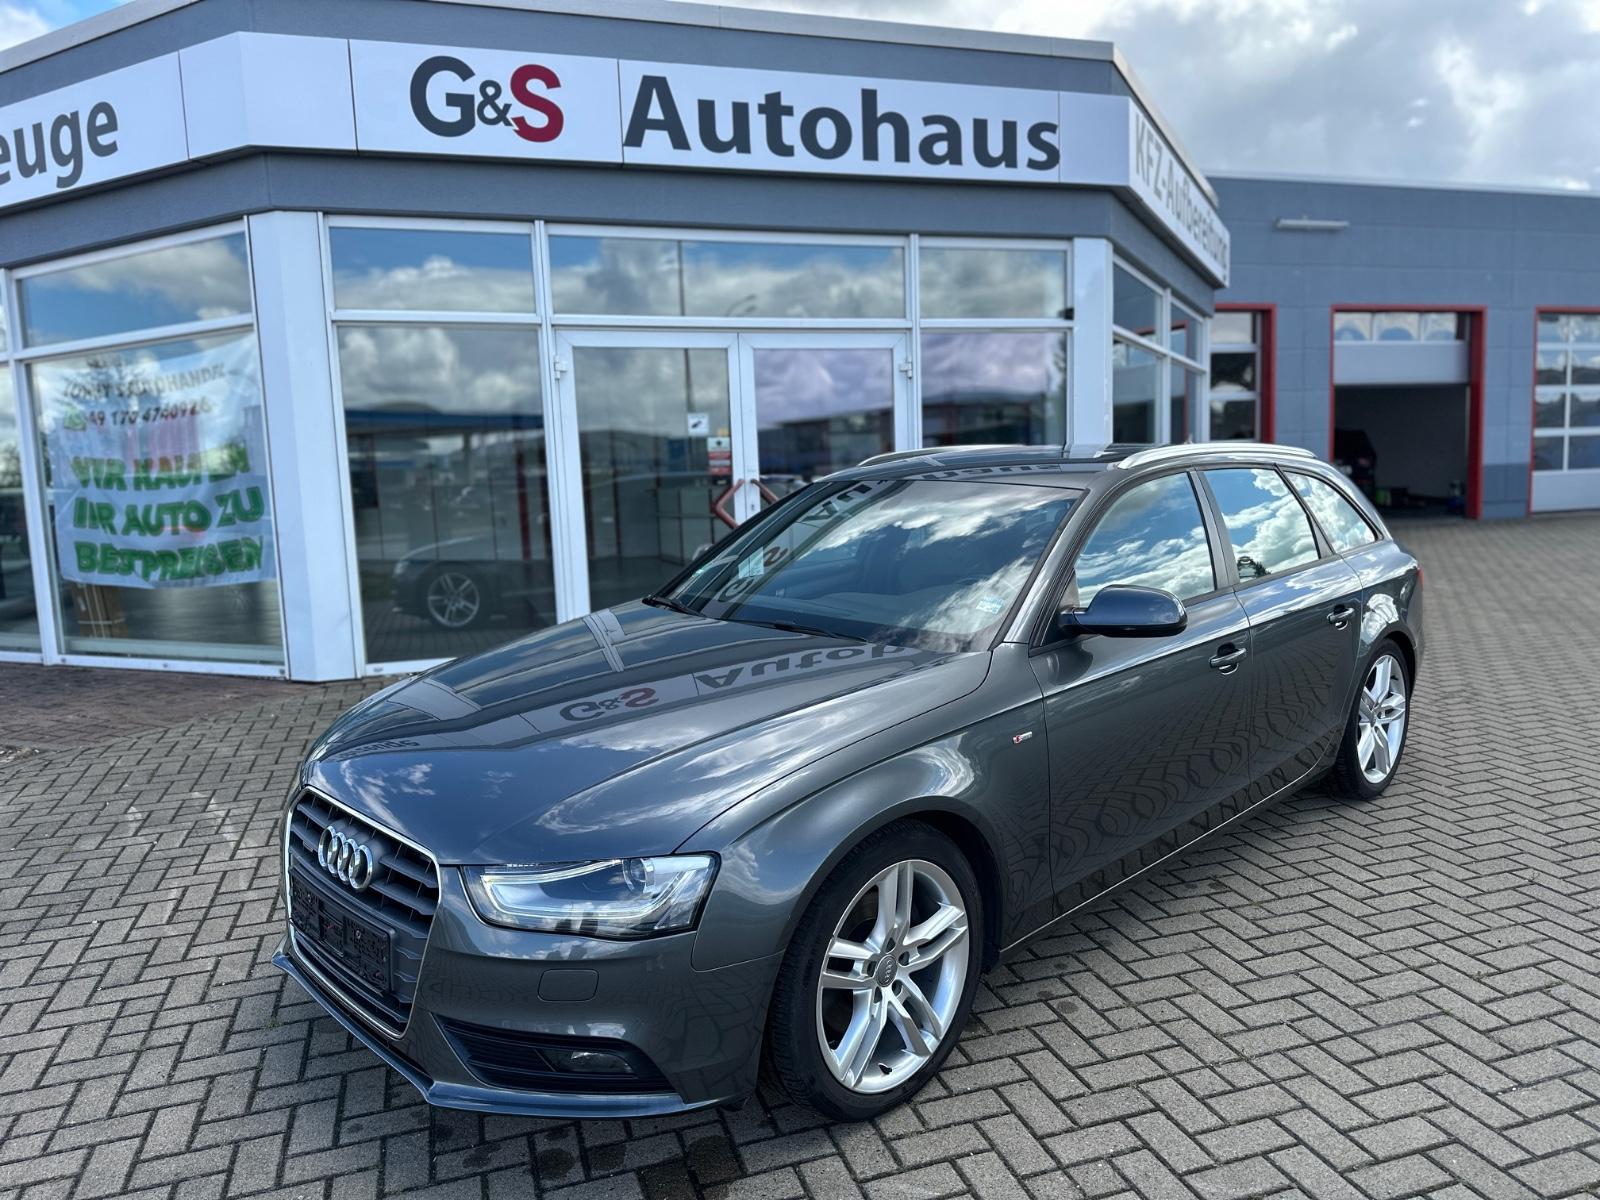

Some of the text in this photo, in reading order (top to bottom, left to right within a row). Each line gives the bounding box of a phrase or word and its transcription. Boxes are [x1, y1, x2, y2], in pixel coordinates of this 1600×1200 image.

[409, 55, 1061, 171] G&S Autohaus
[122, 499, 213, 537] AUTO
[215, 485, 265, 529] ZU
